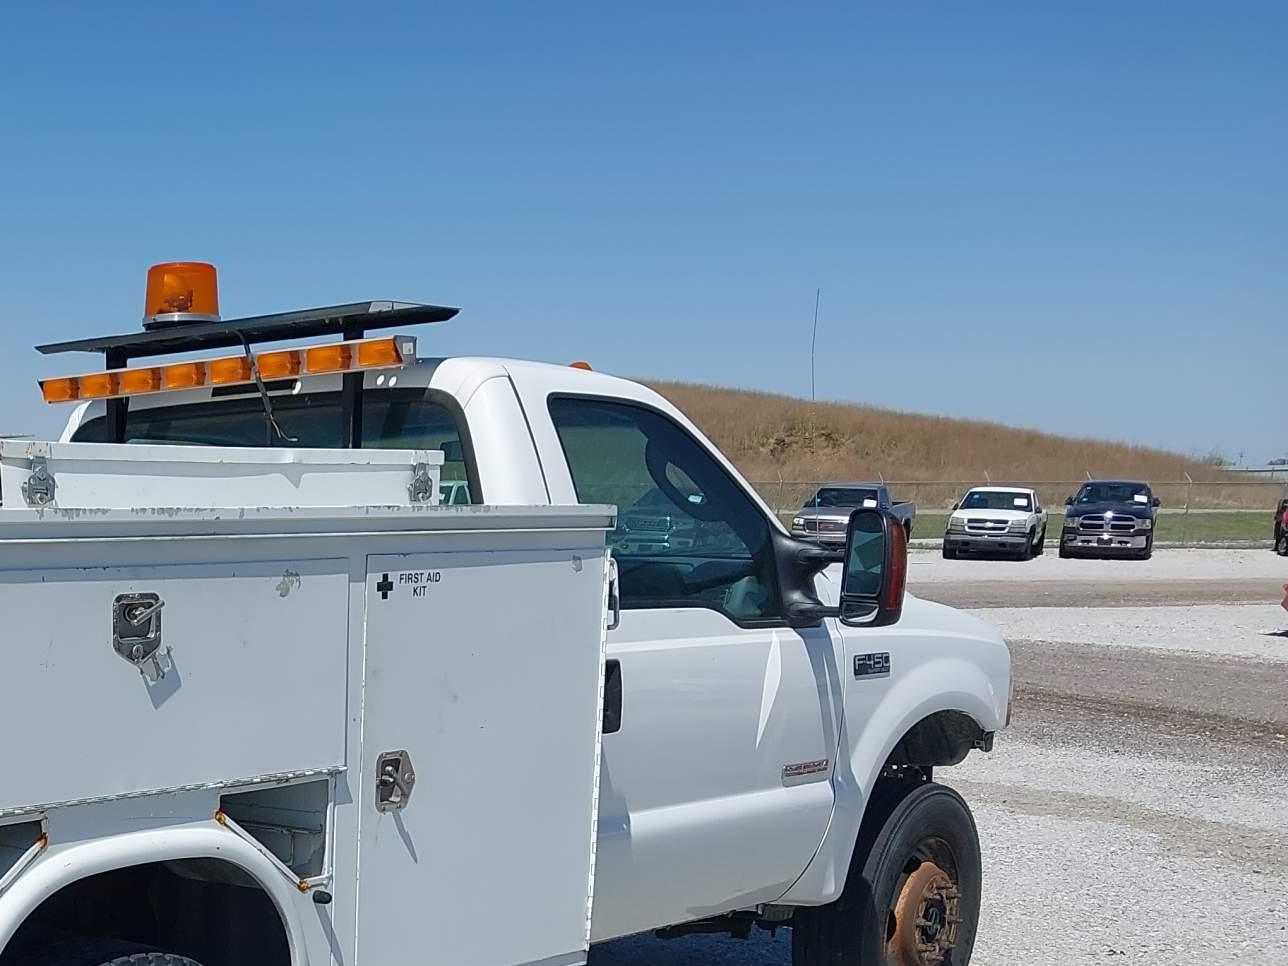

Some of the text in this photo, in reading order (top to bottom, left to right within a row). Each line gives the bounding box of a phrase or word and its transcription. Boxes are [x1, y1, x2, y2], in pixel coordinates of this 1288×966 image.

[399, 571, 441, 584] FIRST AID
[412, 585, 427, 597] KIT
